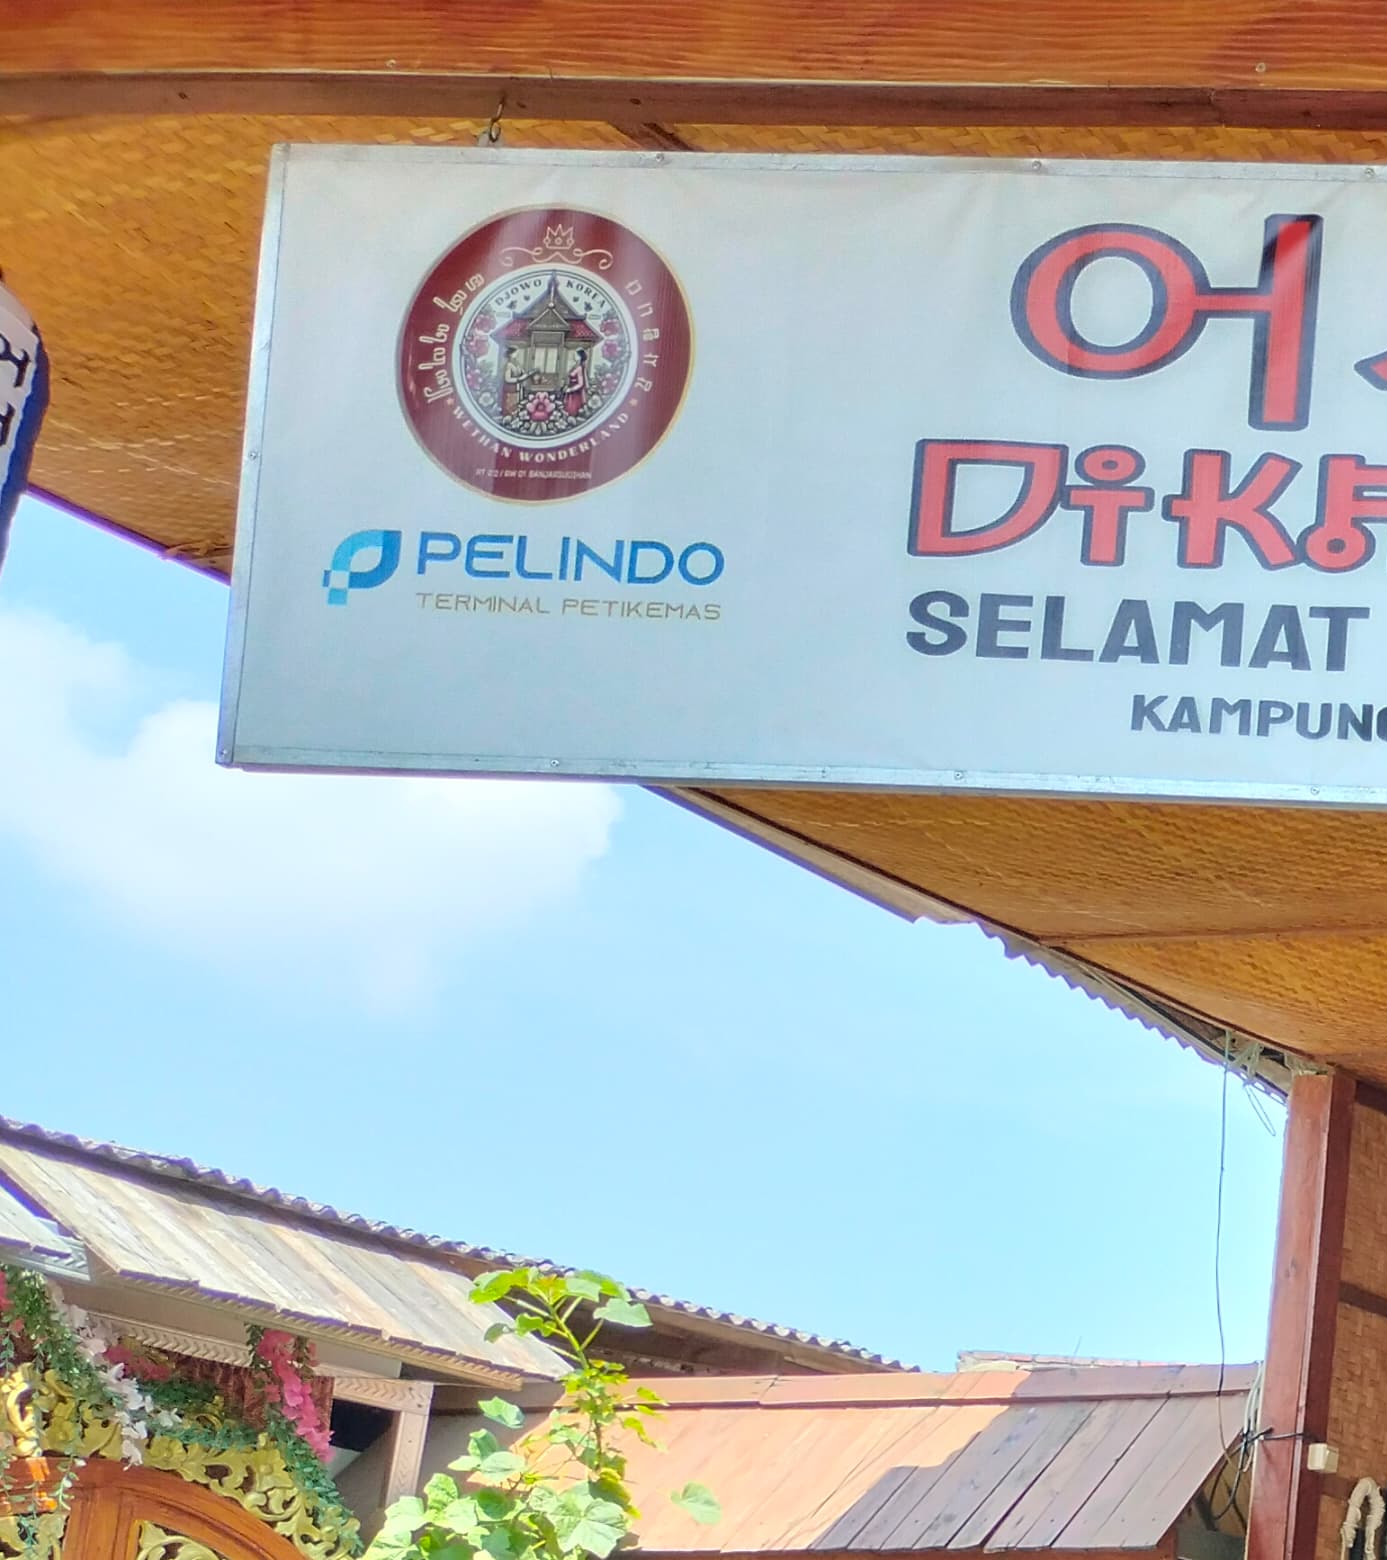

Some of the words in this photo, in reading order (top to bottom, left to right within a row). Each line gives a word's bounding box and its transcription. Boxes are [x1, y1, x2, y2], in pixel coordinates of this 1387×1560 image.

[519, 411, 630, 463] WONDERLAND
[417, 530, 725, 586] PELINDO
[416, 592, 549, 616] TERMINAL
[562, 598, 721, 620] PETIKEMAS
[905, 589, 1369, 672] SELAMAT
